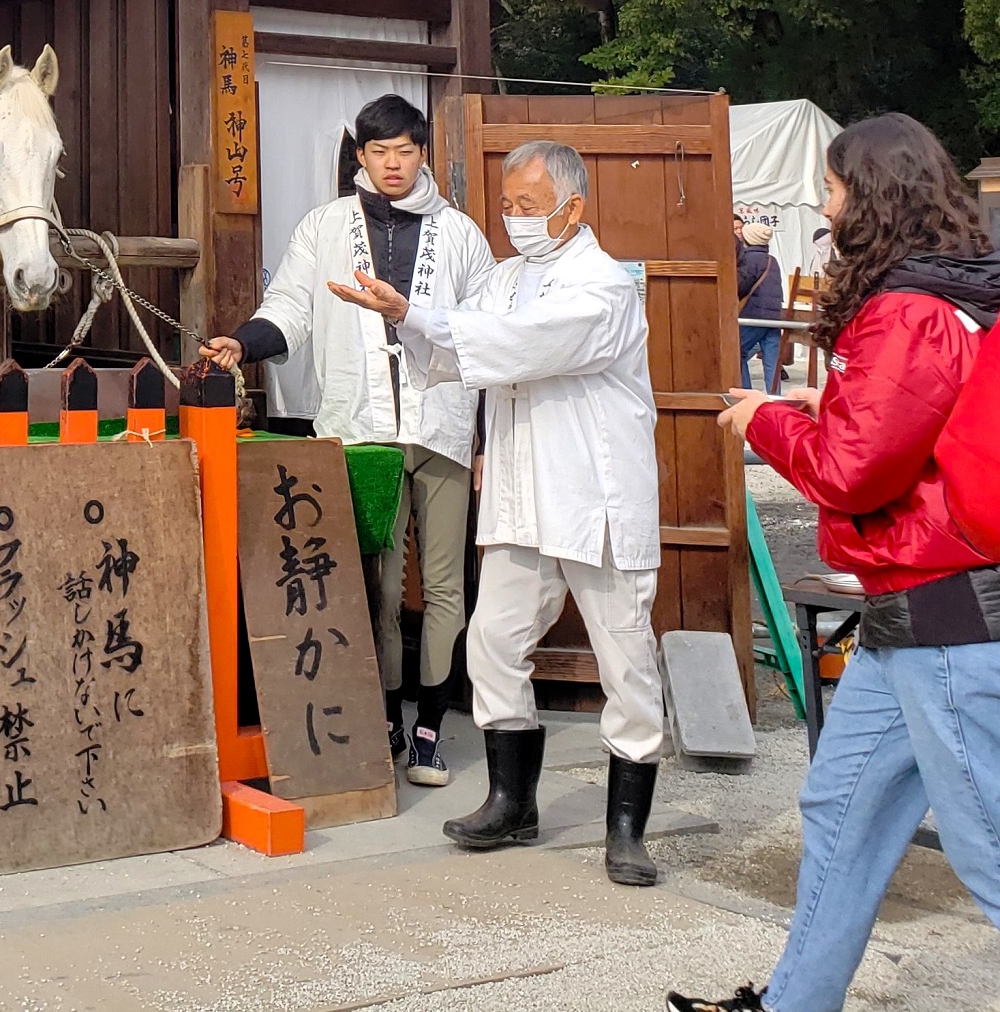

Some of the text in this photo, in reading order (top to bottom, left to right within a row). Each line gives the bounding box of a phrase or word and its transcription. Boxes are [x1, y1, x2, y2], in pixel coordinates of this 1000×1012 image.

[349, 210, 371, 292] 上賀茂神
[414, 215, 439, 297] 上賀茂神社
[57, 570, 107, 816] 話しかけないで下さい
[95, 537, 144, 723] 神馬に
[273, 464, 350, 756] お静かに
